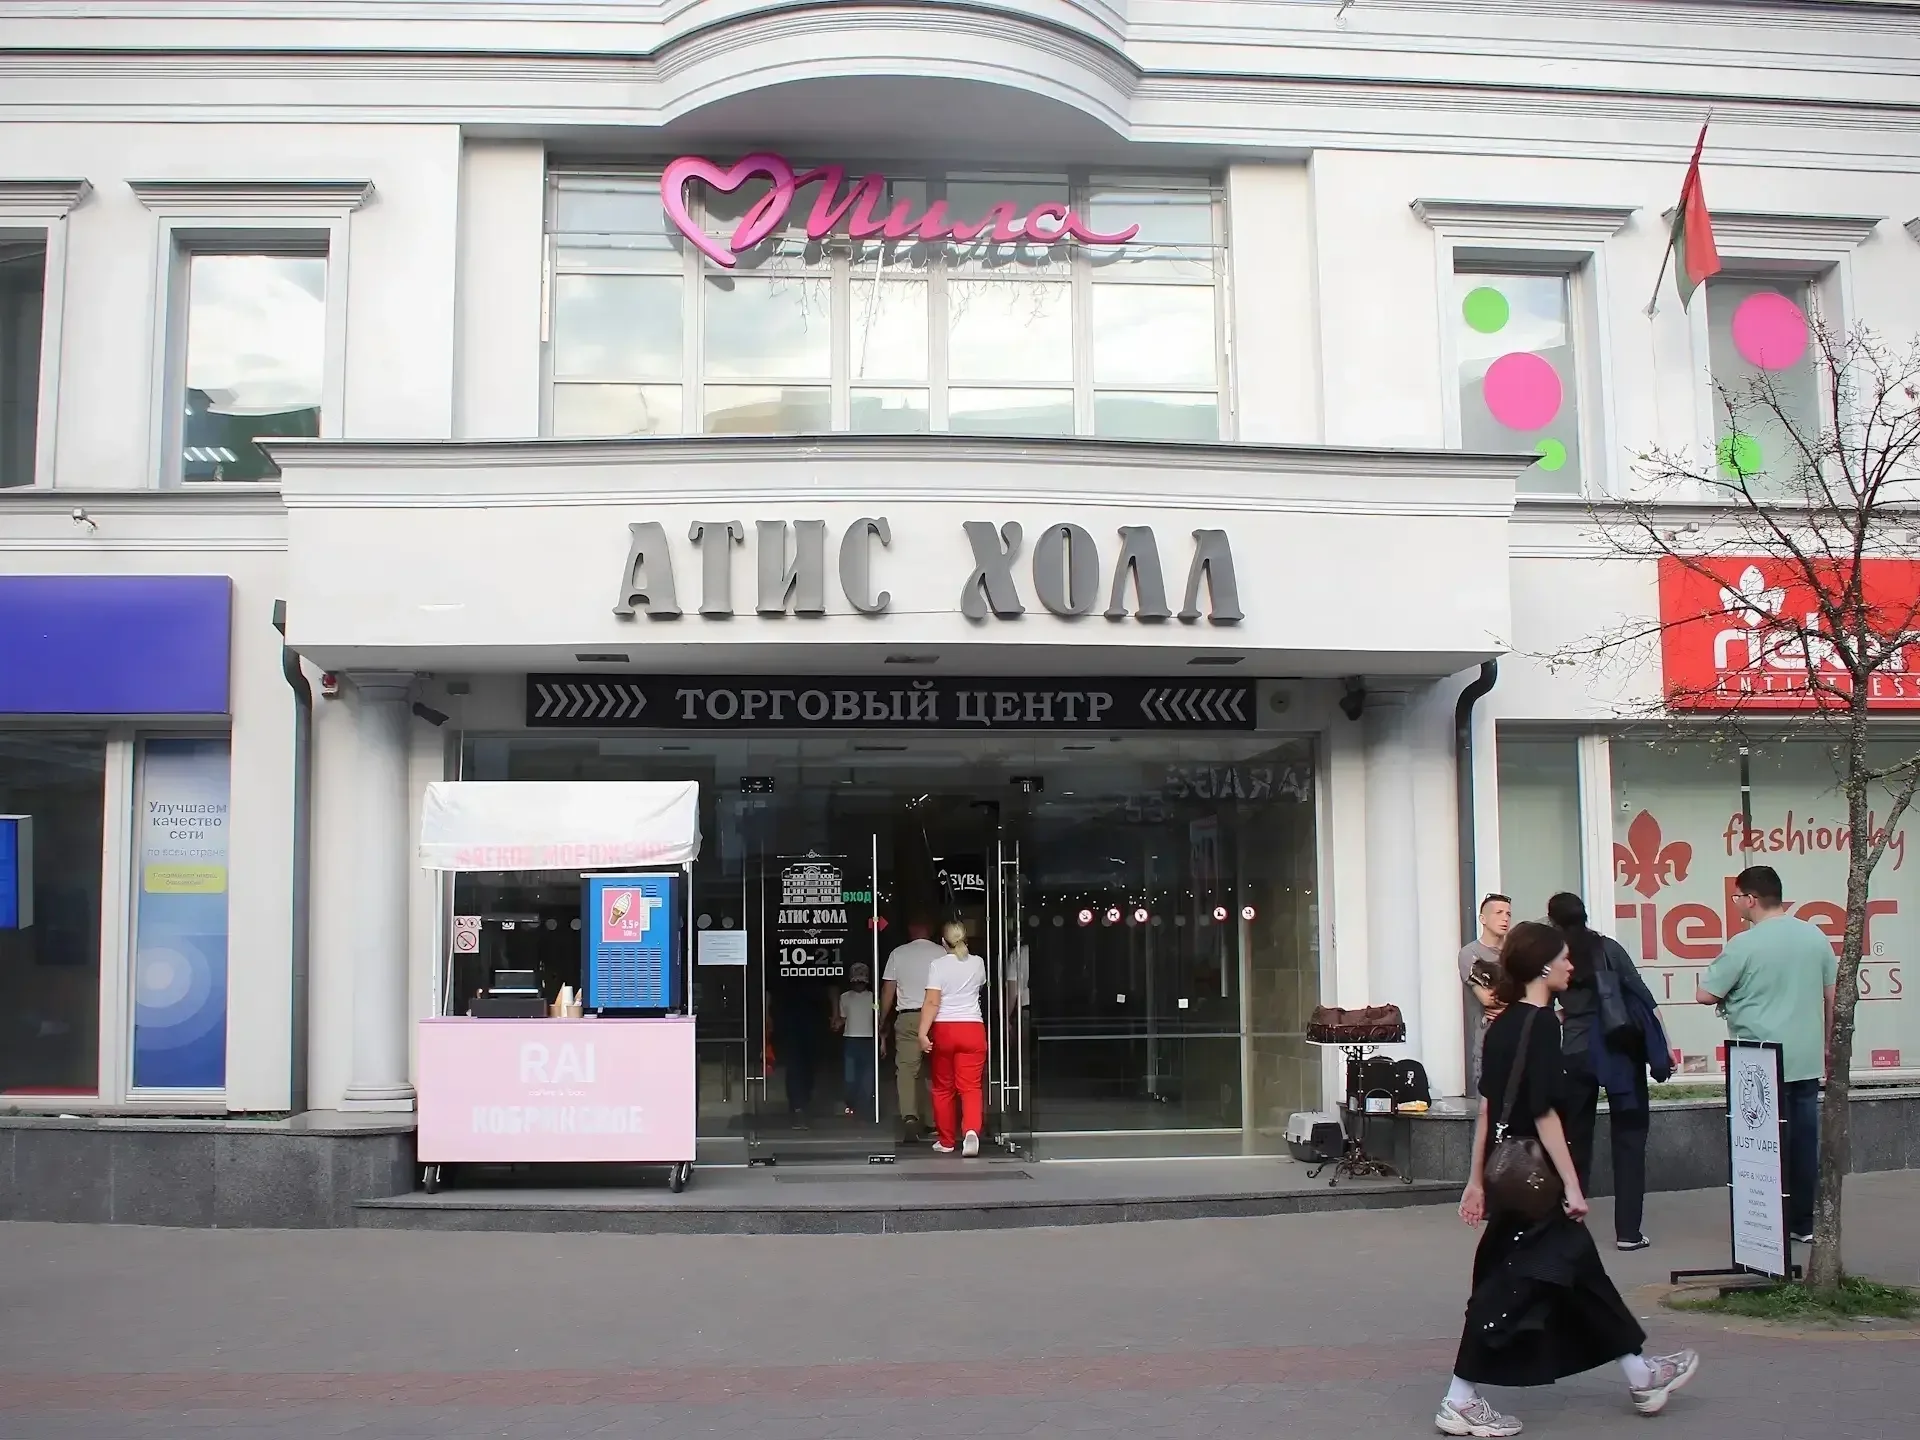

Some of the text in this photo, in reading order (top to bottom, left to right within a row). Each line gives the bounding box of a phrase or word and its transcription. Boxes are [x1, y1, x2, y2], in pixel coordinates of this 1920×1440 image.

[612, 516, 1245, 622] АТИС ХОЛЛ
[675, 681, 1114, 727] ТОРГОВЫЙ ЦЕНТР
[149, 801, 228, 816] Улучшаем
[153, 817, 222, 827] качество
[169, 830, 204, 840] сети
[1723, 810, 1905, 871] fashion by
[842, 891, 872, 904] ВХОД
[778, 909, 848, 925] АТИС ХОЛЛ
[780, 937, 844, 946] ТОРГОВЫЙ ЦЕНТР
[779, 947, 844, 966] 10-21
[519, 1041, 596, 1084] RAI
[1734, 1135, 1778, 1154] JUST VAPE
